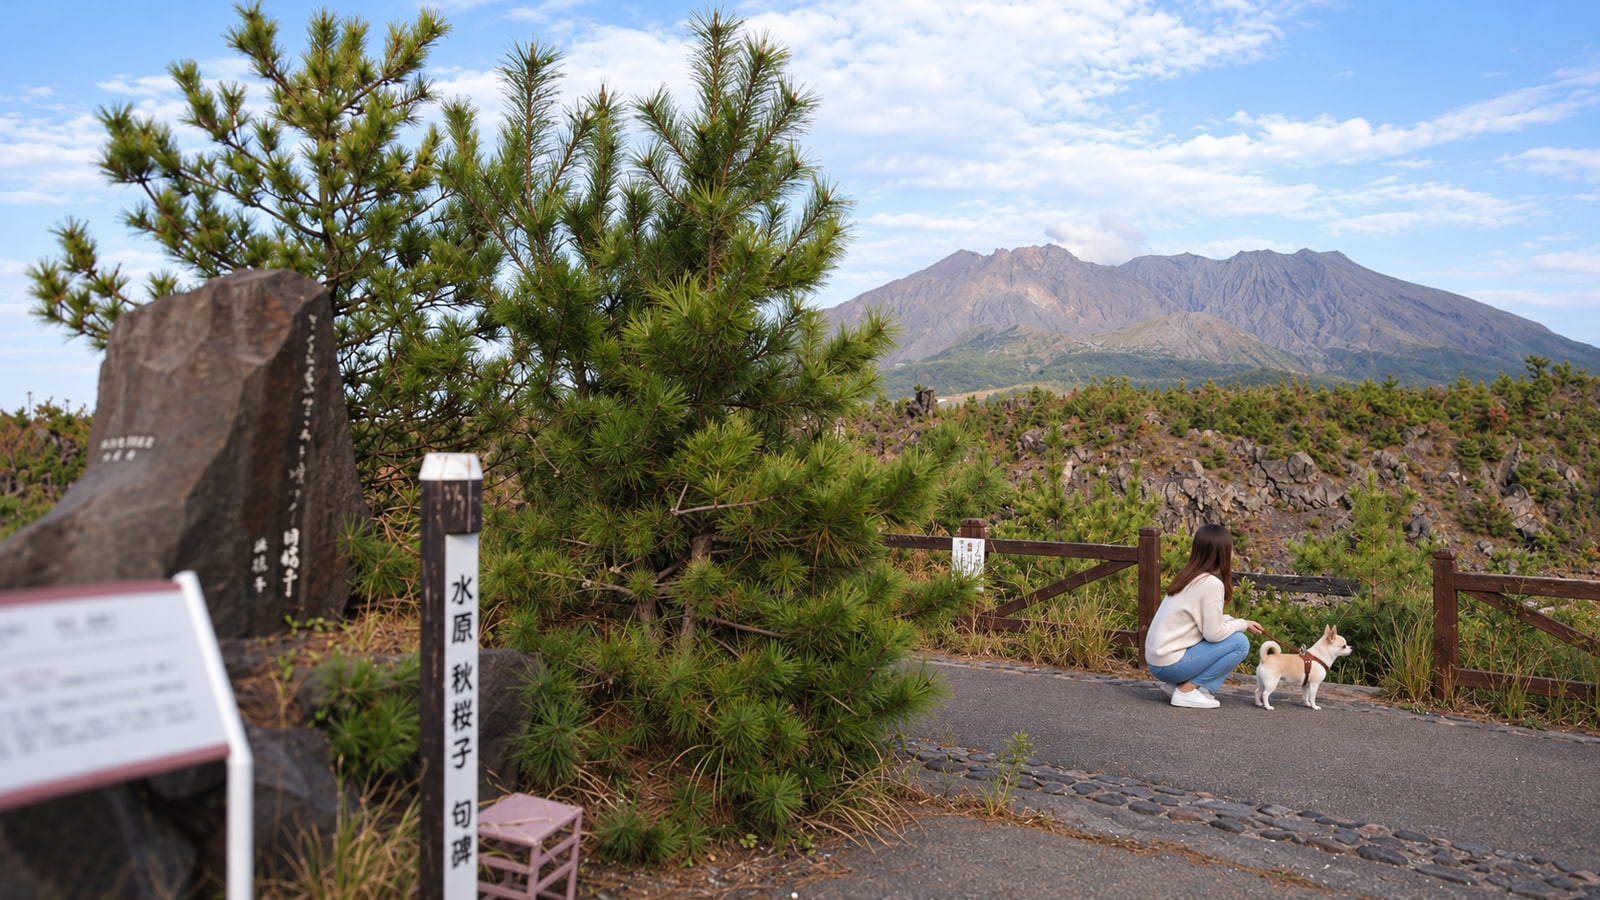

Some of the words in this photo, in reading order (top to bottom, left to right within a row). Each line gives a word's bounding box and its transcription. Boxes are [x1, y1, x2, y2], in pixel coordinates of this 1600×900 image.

[451, 574, 473, 644] 水原
[451, 662, 473, 770] 秋桜子
[451, 799, 472, 869] 句碑
